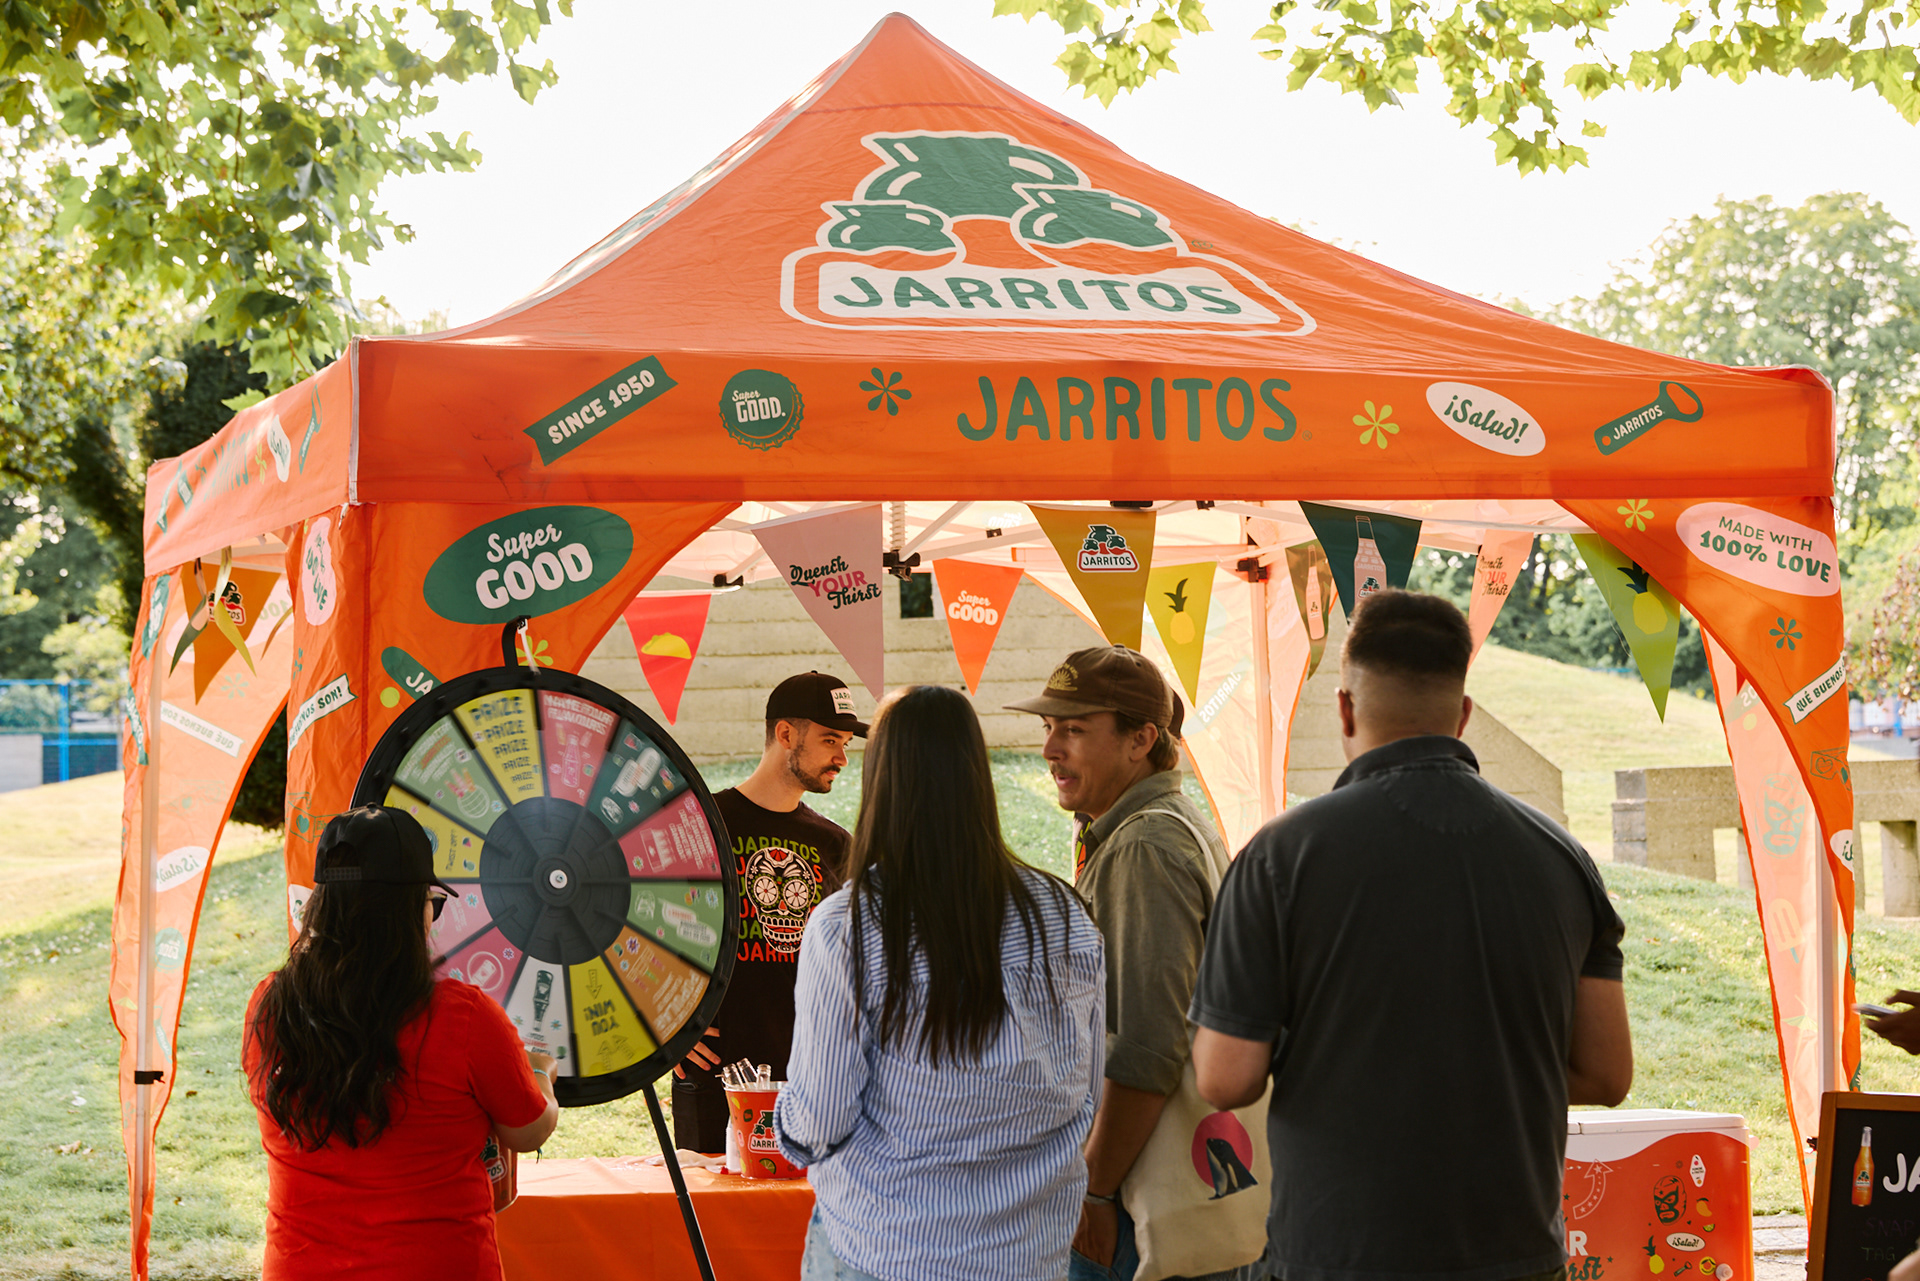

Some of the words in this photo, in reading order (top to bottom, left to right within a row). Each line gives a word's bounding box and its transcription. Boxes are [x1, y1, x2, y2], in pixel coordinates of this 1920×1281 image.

[833, 275, 1243, 315] JARRITOS
[547, 398, 607, 445] SINCE
[608, 369, 656, 409] 1950
[732, 390, 761, 402] Super
[735, 396, 786, 423] GOOD.
[957, 375, 1297, 442] JARRITOS
[1444, 394, 1529, 444] ¡Salud!
[1613, 404, 1663, 440] JARRITOS
[486, 523, 563, 563] Super
[1719, 516, 1765, 541] MADE
[1769, 531, 1813, 552] WITH
[789, 556, 849, 587] Quench
[1083, 556, 1132, 567] JARRITOS
[1700, 530, 1768, 563] 100%
[1777, 550, 1831, 583] LOVE
[475, 542, 594, 610] GOOD
[807, 570, 868, 598] YOUR
[827, 583, 882, 609] Thirst
[958, 590, 991, 607] Super
[948, 602, 998, 626] GOOD
[317, 686, 343, 709] SON!
[1796, 691, 1813, 712] QUÉ
[1813, 667, 1842, 698] BUENOS
[469, 696, 524, 726] PRIZE
[484, 719, 527, 743] PRIZE
[493, 738, 528, 758] PRIZE
[1861, 1246, 1895, 1261] TAG
